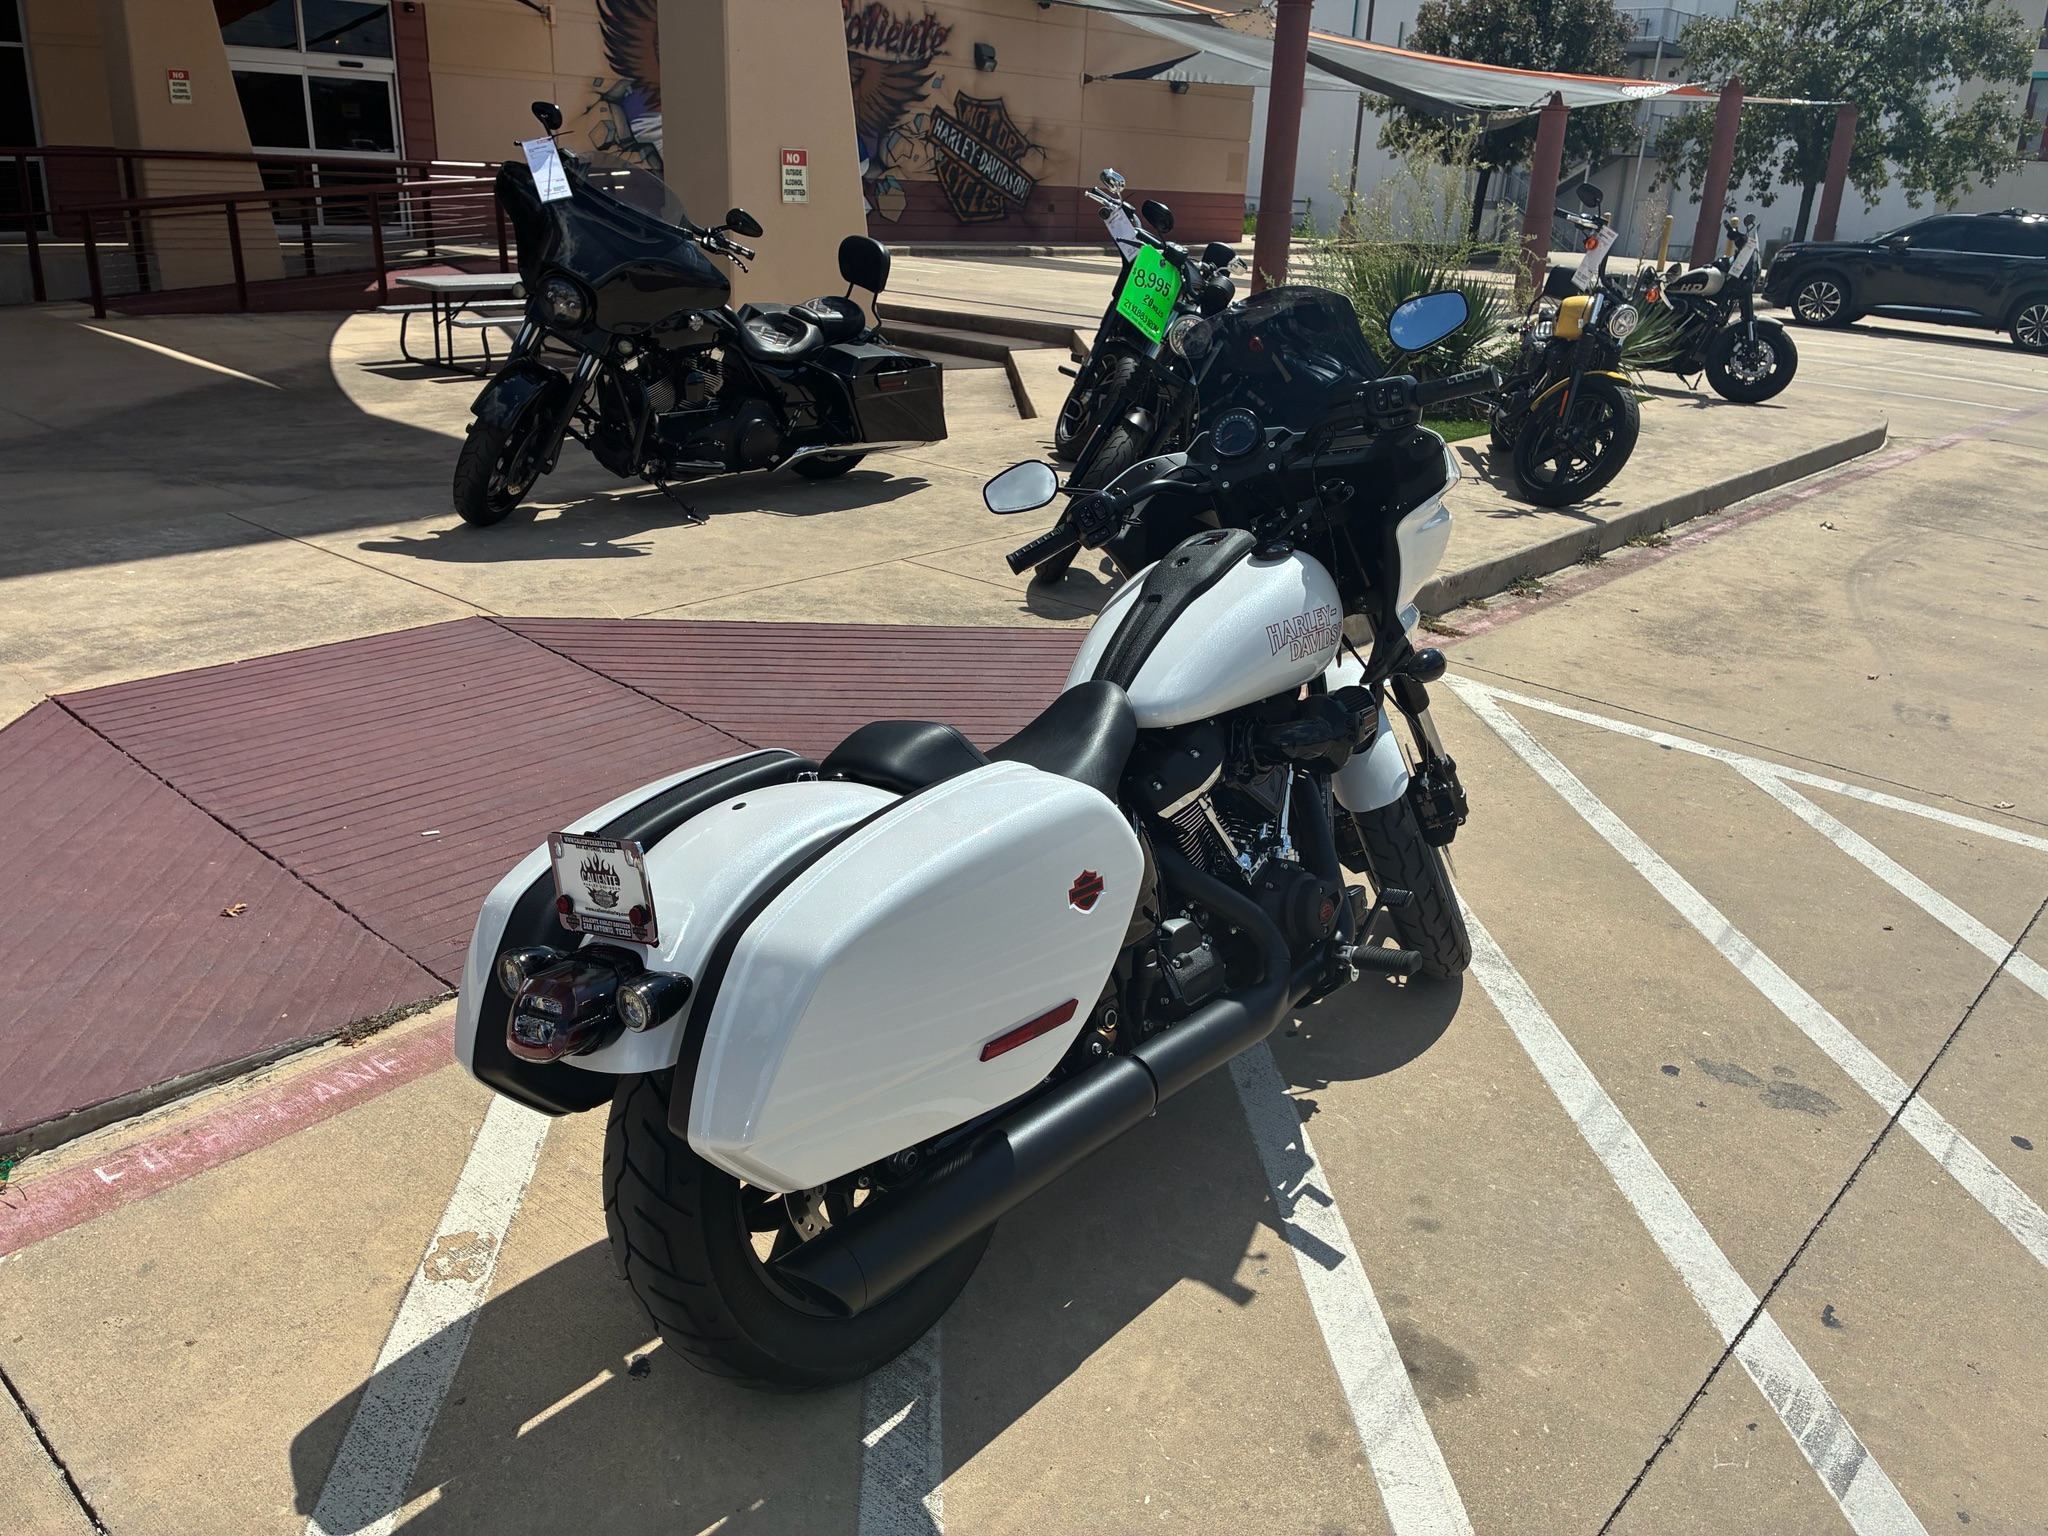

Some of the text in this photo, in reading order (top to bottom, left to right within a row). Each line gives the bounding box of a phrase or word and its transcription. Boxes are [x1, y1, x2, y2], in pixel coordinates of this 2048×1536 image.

[842, 0, 952, 56] aliente
[172, 71, 184, 79] NO
[963, 105, 1017, 157] MOTOR
[786, 153, 800, 164] NO
[933, 118, 1029, 199] HARLEY-DAVIDSON
[945, 161, 999, 212] CYCLES
[1266, 604, 1337, 656] HARLEY-
[582, 870, 619, 886] CALIENTE
[583, 922, 593, 931] SAN
[616, 928, 632, 937] TEXAS
